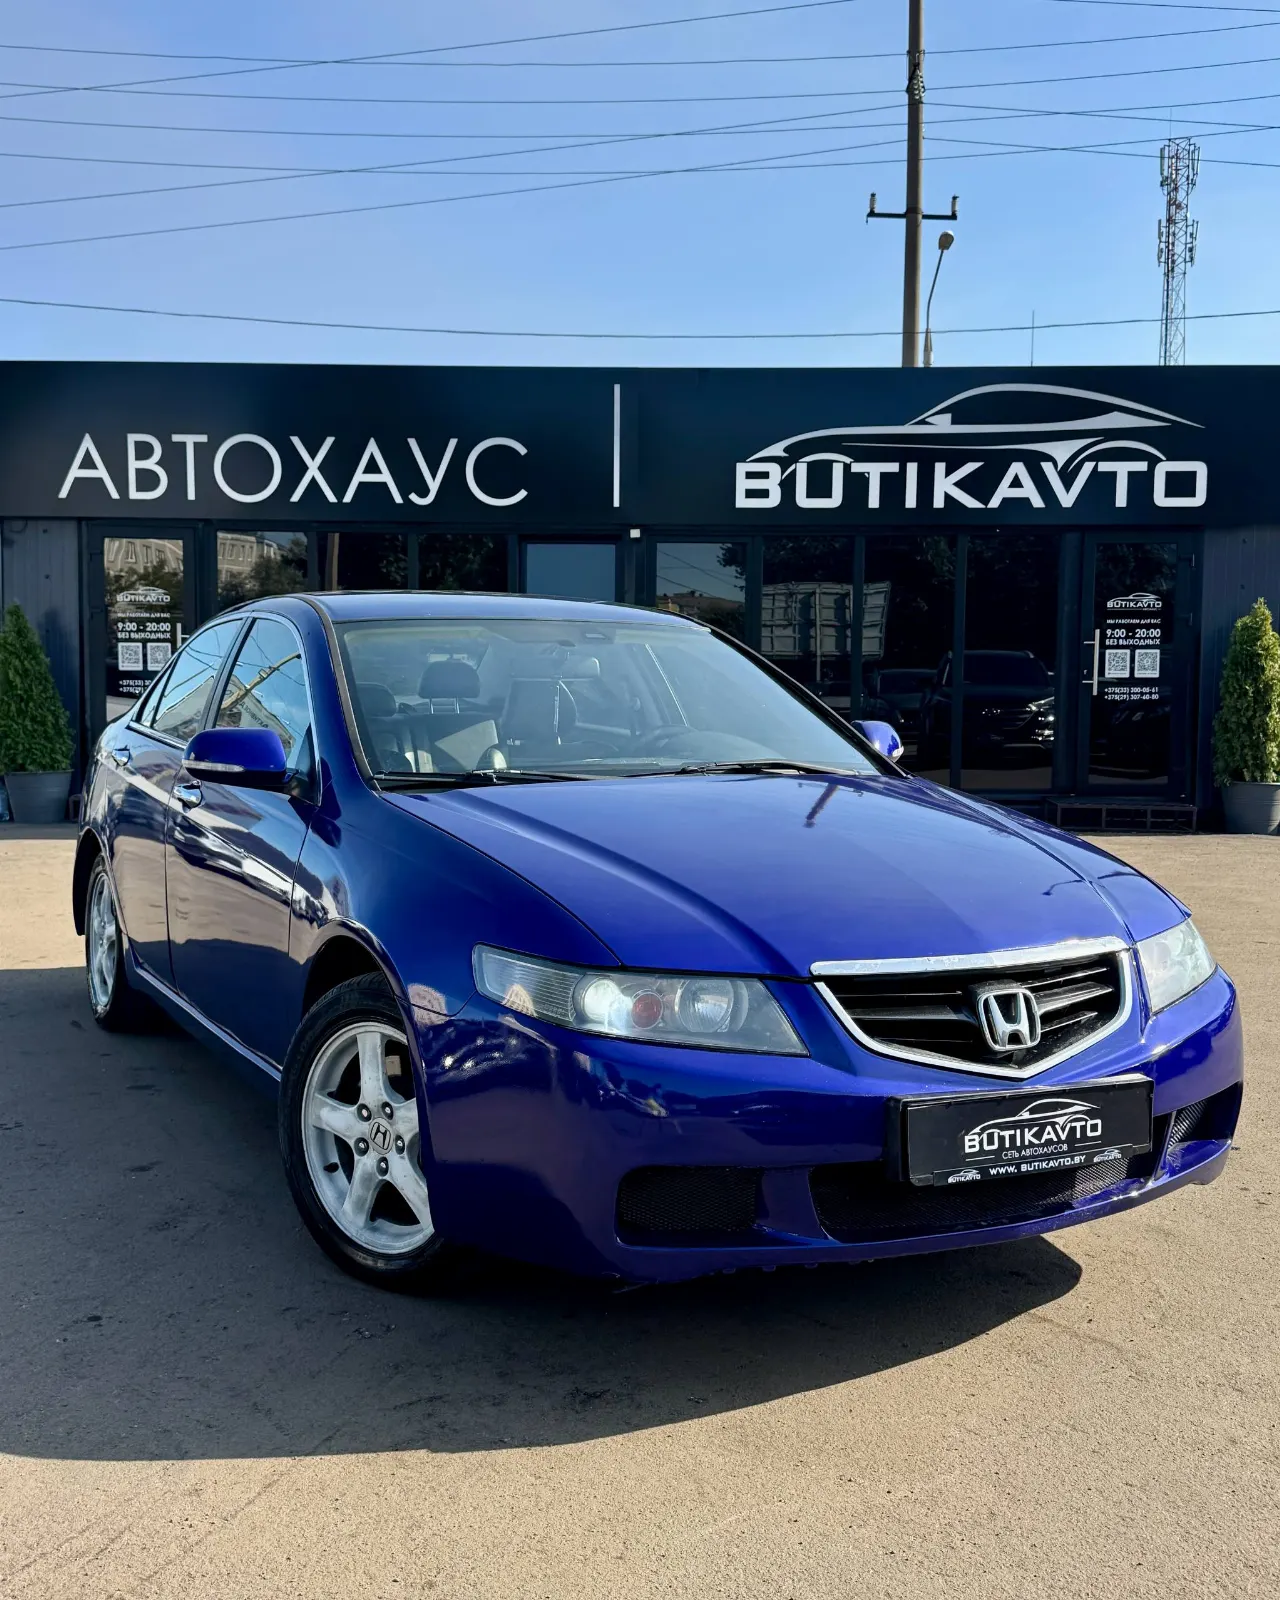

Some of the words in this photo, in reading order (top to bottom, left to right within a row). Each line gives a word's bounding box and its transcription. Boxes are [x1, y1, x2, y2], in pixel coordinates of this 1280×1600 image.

[57, 432, 529, 507] АВТОХАУС
[735, 460, 1208, 510] BUTIKAVTO
[117, 622, 137, 631] 9:00
[145, 622, 171, 631] 20:00
[117, 631, 130, 639] БЕЗ
[130, 631, 171, 640] ВЫХОДНЫХ
[1106, 628, 1126, 638] 9:00
[1134, 628, 1161, 638] 20:00
[1118, 638, 1161, 646] ВЫХОДНЫХ
[1104, 686, 1130, 694] +375(33)
[964, 1118, 1102, 1154] BUTIKAVTO
[1002, 1149, 1020, 1160] СЕТЬ
[1020, 1143, 1068, 1158] АВТОХАУСОВ
[947, 1173, 981, 1184] BUTIKAVTO
